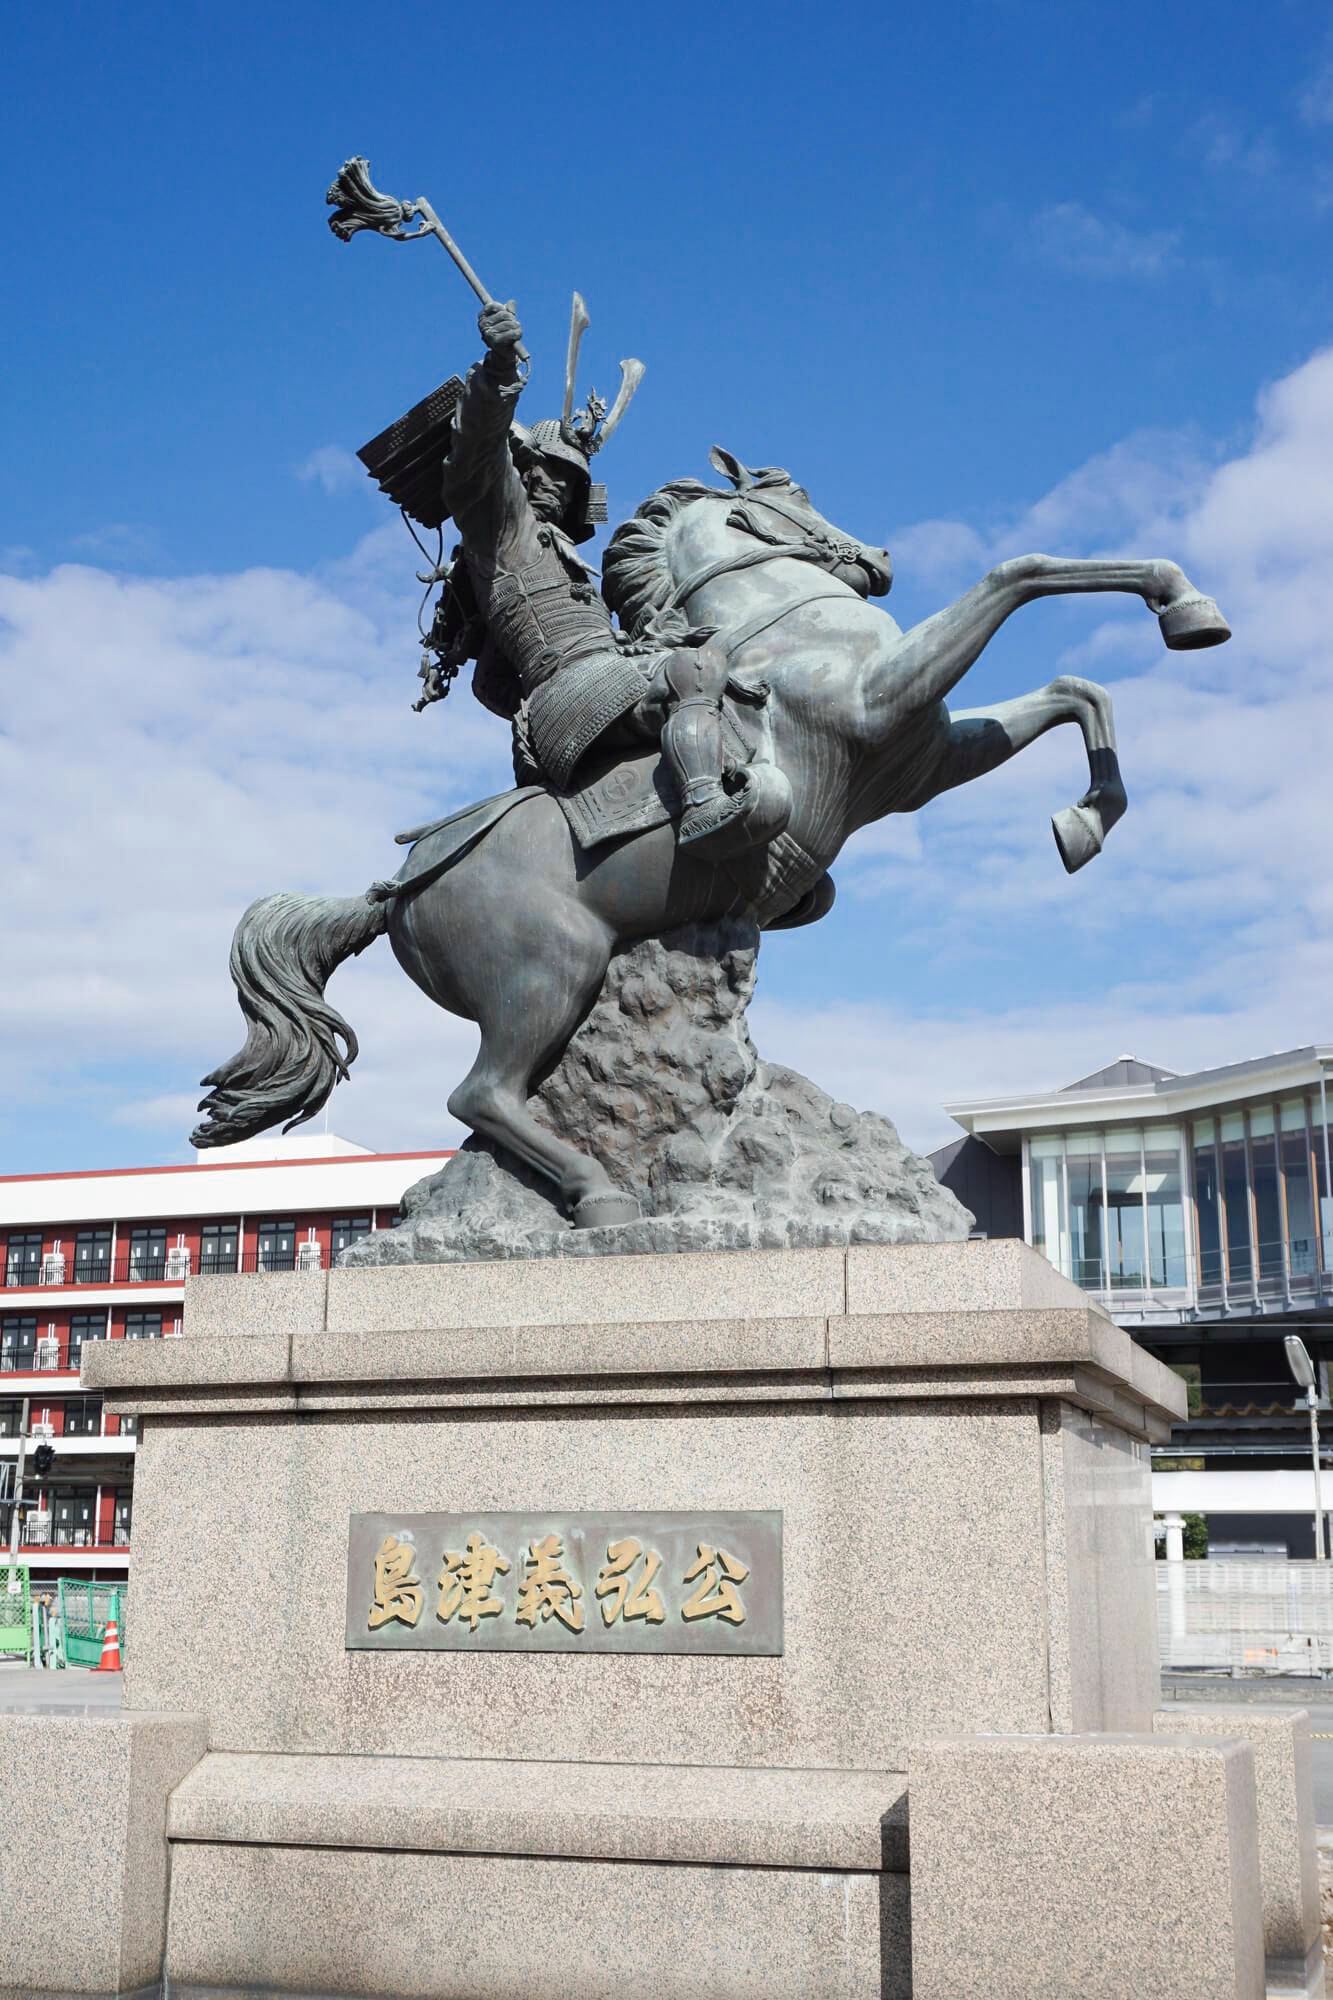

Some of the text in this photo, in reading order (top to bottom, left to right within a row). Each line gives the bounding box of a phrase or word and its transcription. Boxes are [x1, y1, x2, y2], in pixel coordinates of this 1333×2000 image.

[367, 1531, 750, 1633] 島津義弘公
